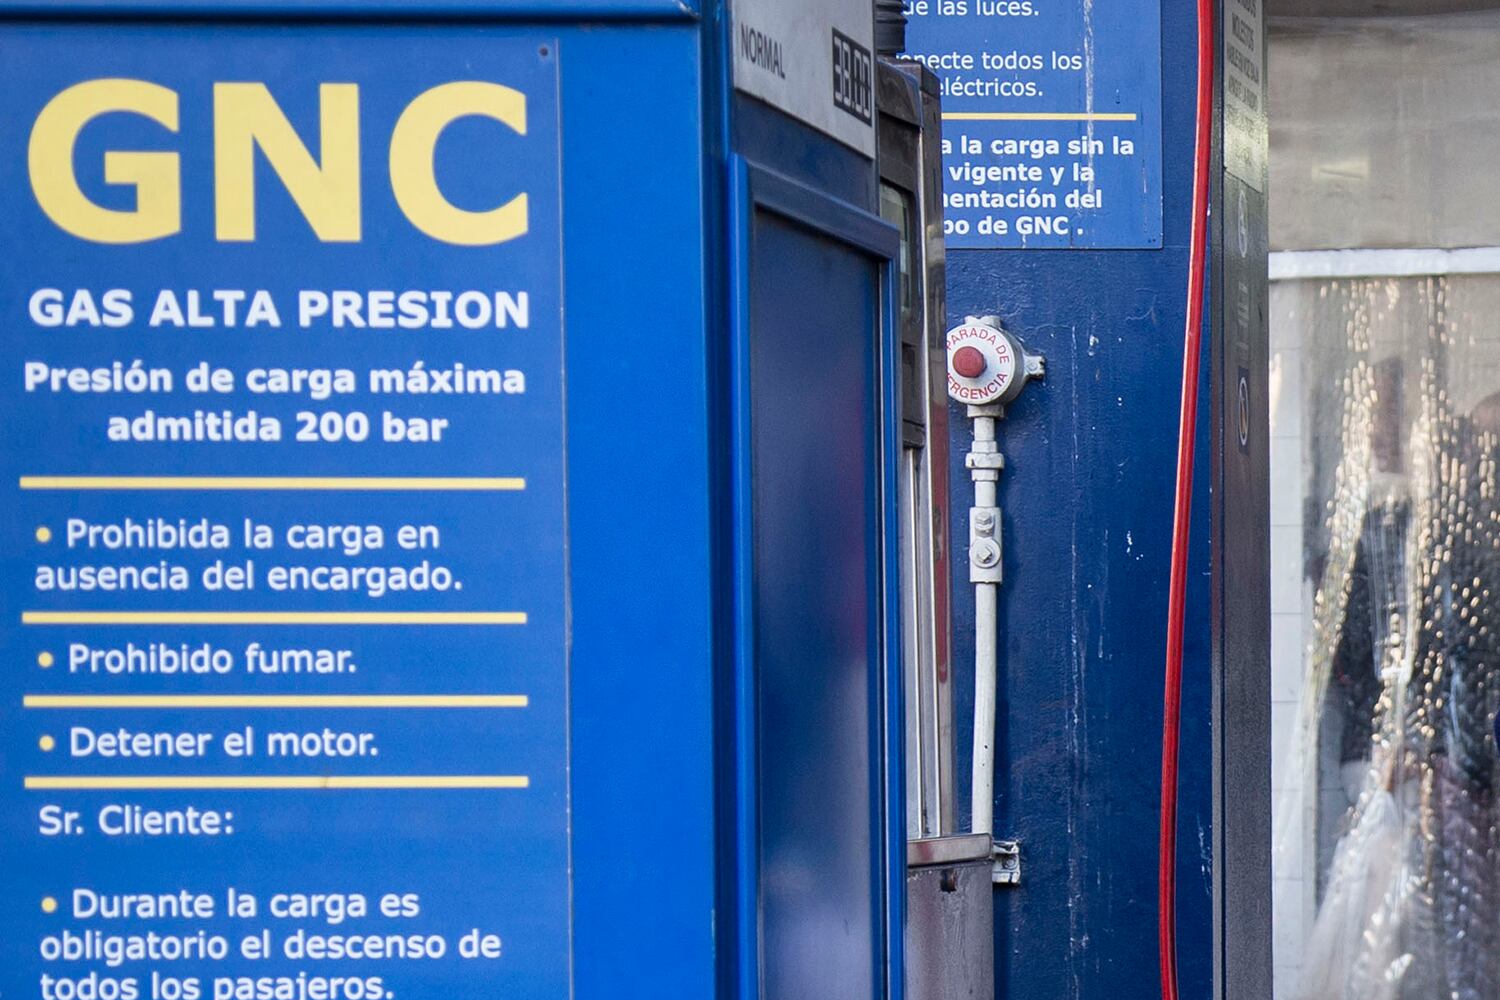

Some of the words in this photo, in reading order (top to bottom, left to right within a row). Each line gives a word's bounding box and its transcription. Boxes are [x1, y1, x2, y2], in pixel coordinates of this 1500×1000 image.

[937, 0, 967, 16] las
[976, 0, 1040, 16] luces.
[741, 23, 786, 80] NORMAL
[982, 51, 1043, 70] todos
[1052, 51, 1082, 70] los
[28, 78, 528, 246] GNC
[961, 136, 983, 155] la
[991, 138, 1060, 159] carga
[1067, 136, 1104, 155] sin
[1112, 136, 1134, 155] la
[949, 163, 1043, 185] vigente
[1050, 166, 1065, 186] y
[1073, 163, 1095, 182] la
[944, 188, 1057, 208] entación
[1065, 190, 1102, 208] del
[978, 216, 1008, 235] de
[1015, 216, 1069, 235] GNC
[29, 289, 133, 326] GAS
[150, 290, 280, 327] ALTA
[299, 291, 528, 328] PRESION
[946, 327, 997, 351] PARADA
[996, 343, 1010, 364] DE
[25, 360, 172, 392] Presión
[186, 362, 233, 392] de
[247, 369, 355, 399] carga
[370, 361, 525, 393] máxima
[108, 411, 281, 441] admitida
[296, 412, 369, 441] 200
[383, 411, 448, 442] bar
[68, 519, 229, 548] Prohibida
[245, 519, 272, 548] la
[287, 525, 383, 555] carga
[398, 525, 439, 549] en
[36, 561, 188, 590] ausencia
[203, 560, 253, 590] del
[268, 561, 462, 598] encargado.
[70, 643, 232, 673] Prohibido
[246, 643, 356, 673] fumar.
[71, 727, 212, 756] Detener
[224, 727, 252, 756] el
[268, 729, 378, 756] motor.
[40, 806, 82, 834] Sr.
[99, 805, 233, 834] Cliente:
[74, 889, 213, 918] Durante
[228, 888, 256, 917] la
[270, 894, 366, 924] carga
[380, 894, 419, 917] es
[41, 931, 227, 966] obligatorio
[241, 929, 269, 959] el
[284, 929, 446, 959] descenso
[459, 929, 501, 958] de
[41, 972, 137, 1000] todos
[153, 972, 200, 1000] los
